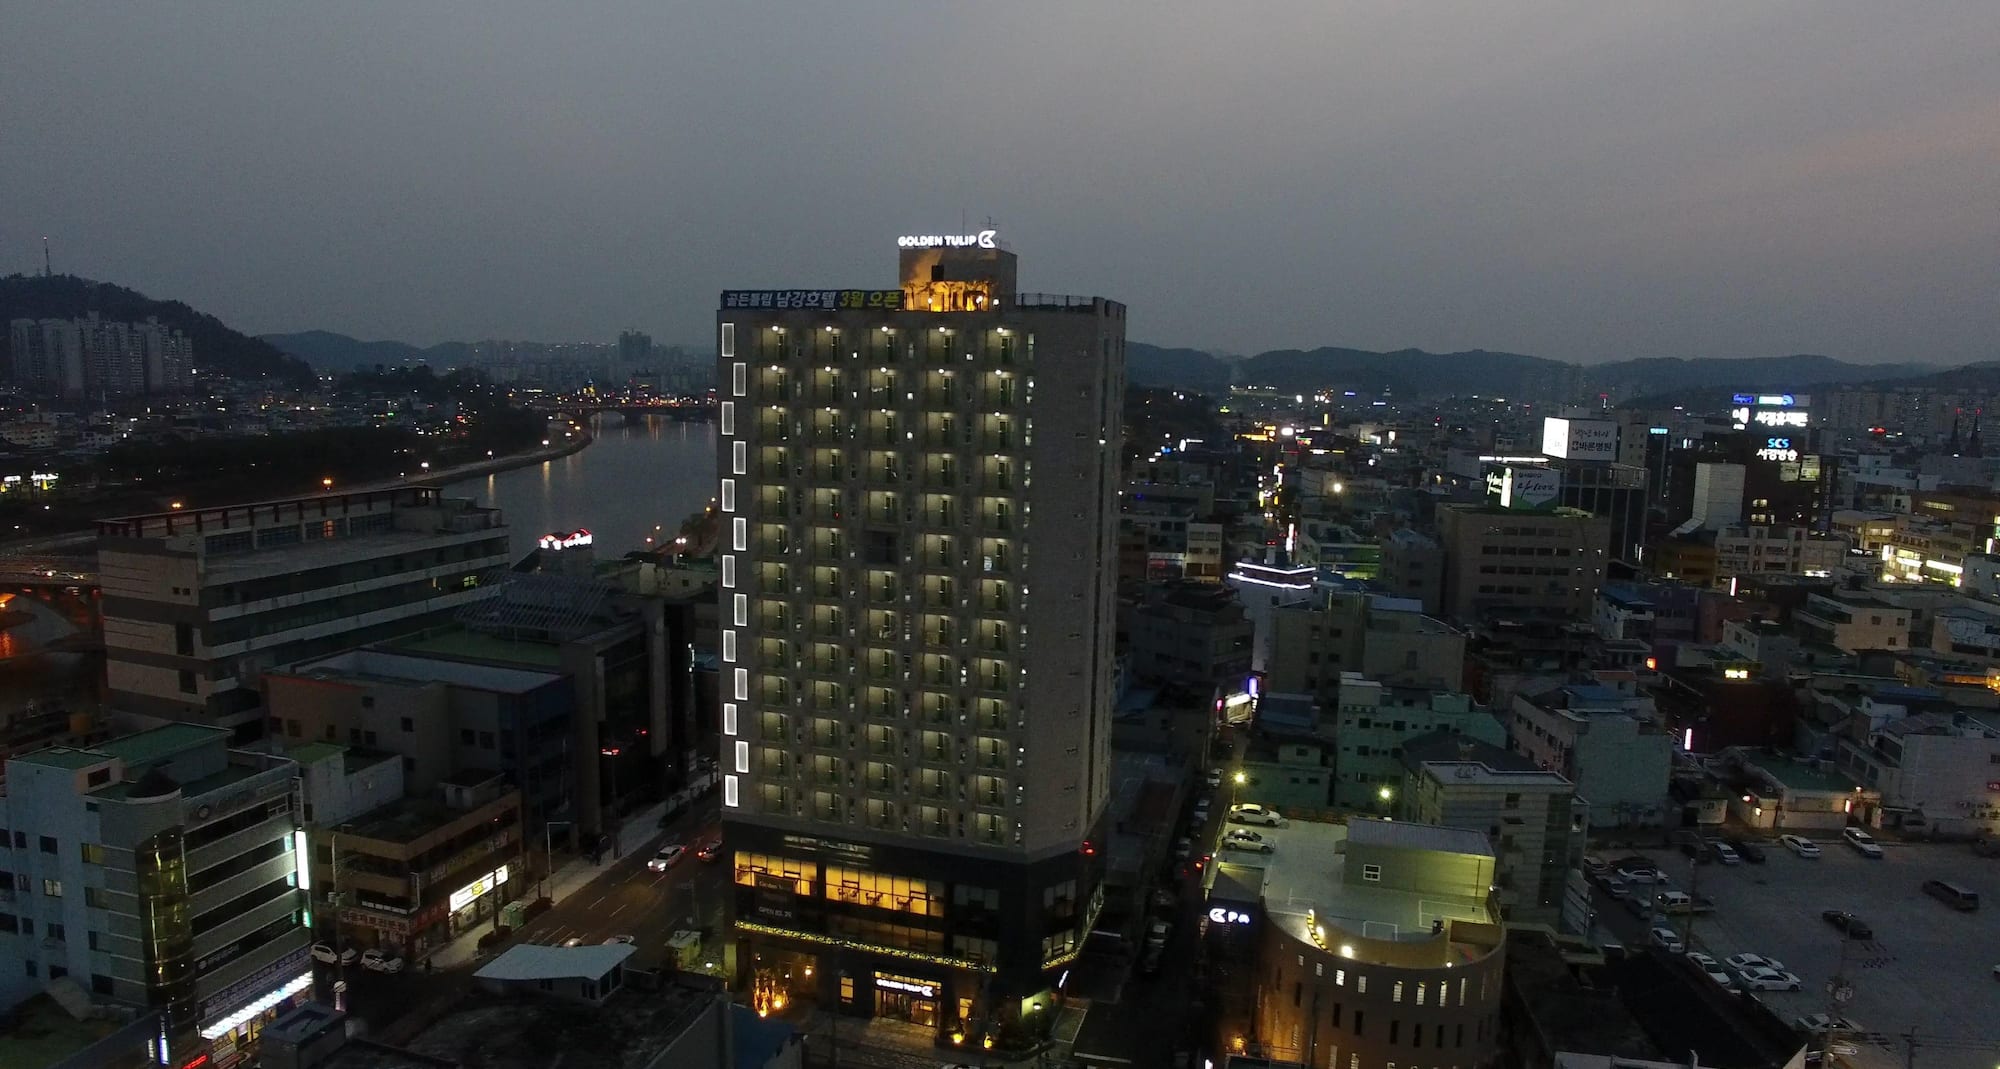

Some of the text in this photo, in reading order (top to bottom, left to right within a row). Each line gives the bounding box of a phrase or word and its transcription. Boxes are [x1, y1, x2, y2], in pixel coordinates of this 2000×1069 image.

[898, 235, 977, 247] GOLDEN TULIP
[776, 291, 837, 309] 남강호텔
[839, 291, 864, 309] 3월
[867, 291, 900, 309] 오픈
[1768, 438, 1789, 448] SCS
[1757, 448, 1798, 461] 서경방송
